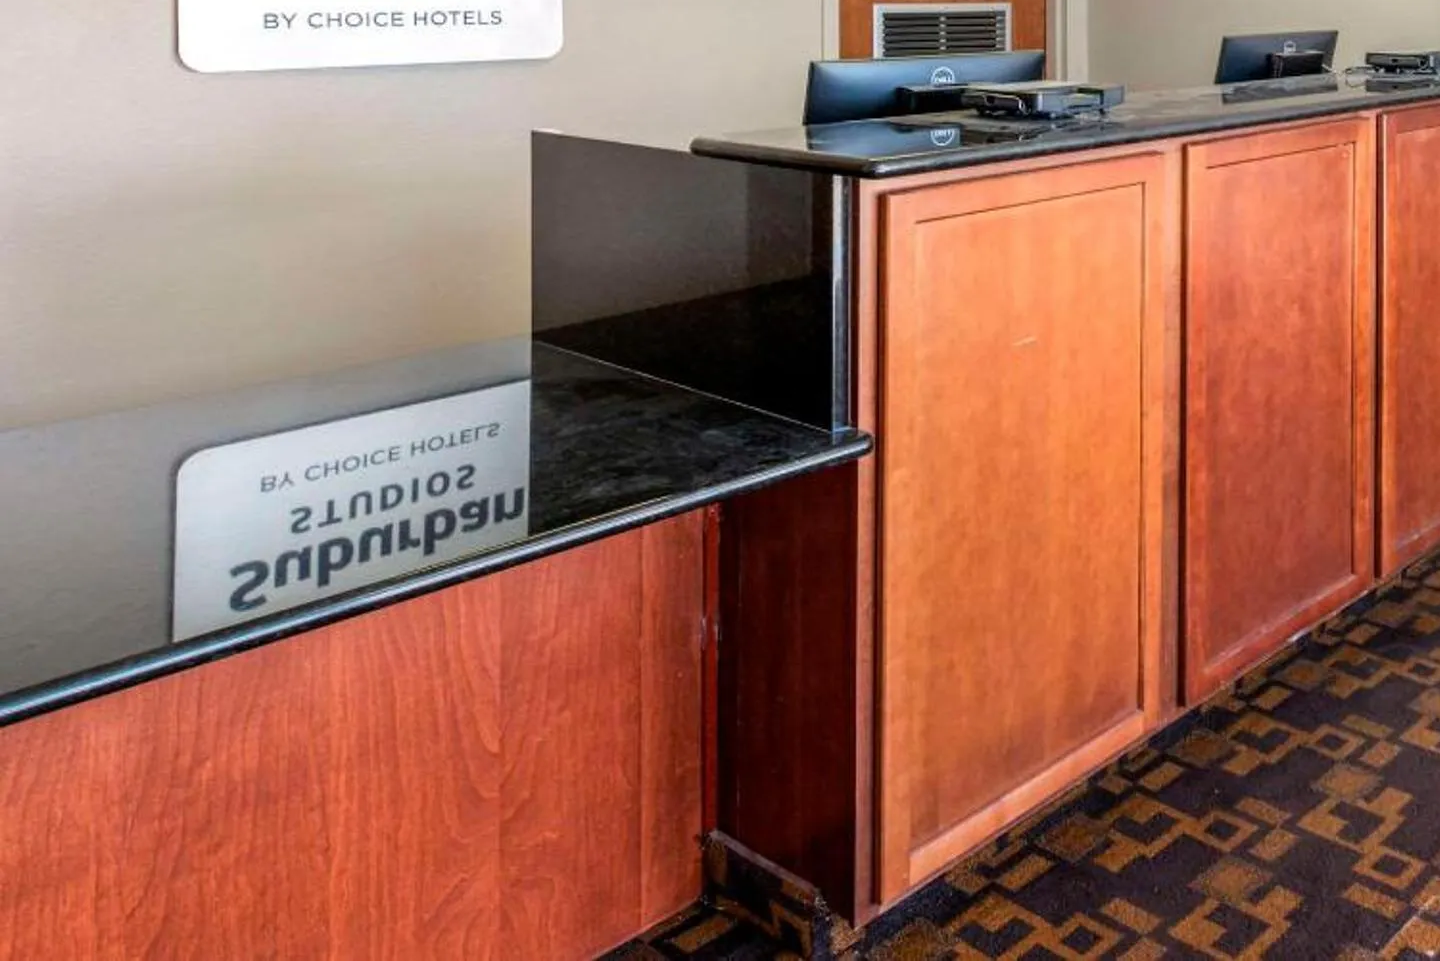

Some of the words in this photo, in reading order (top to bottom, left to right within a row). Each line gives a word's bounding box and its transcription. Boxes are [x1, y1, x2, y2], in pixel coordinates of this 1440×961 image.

[262, 12, 298, 30] BY
[307, 11, 405, 29] CHOICE
[413, 10, 503, 27] HOTELS
